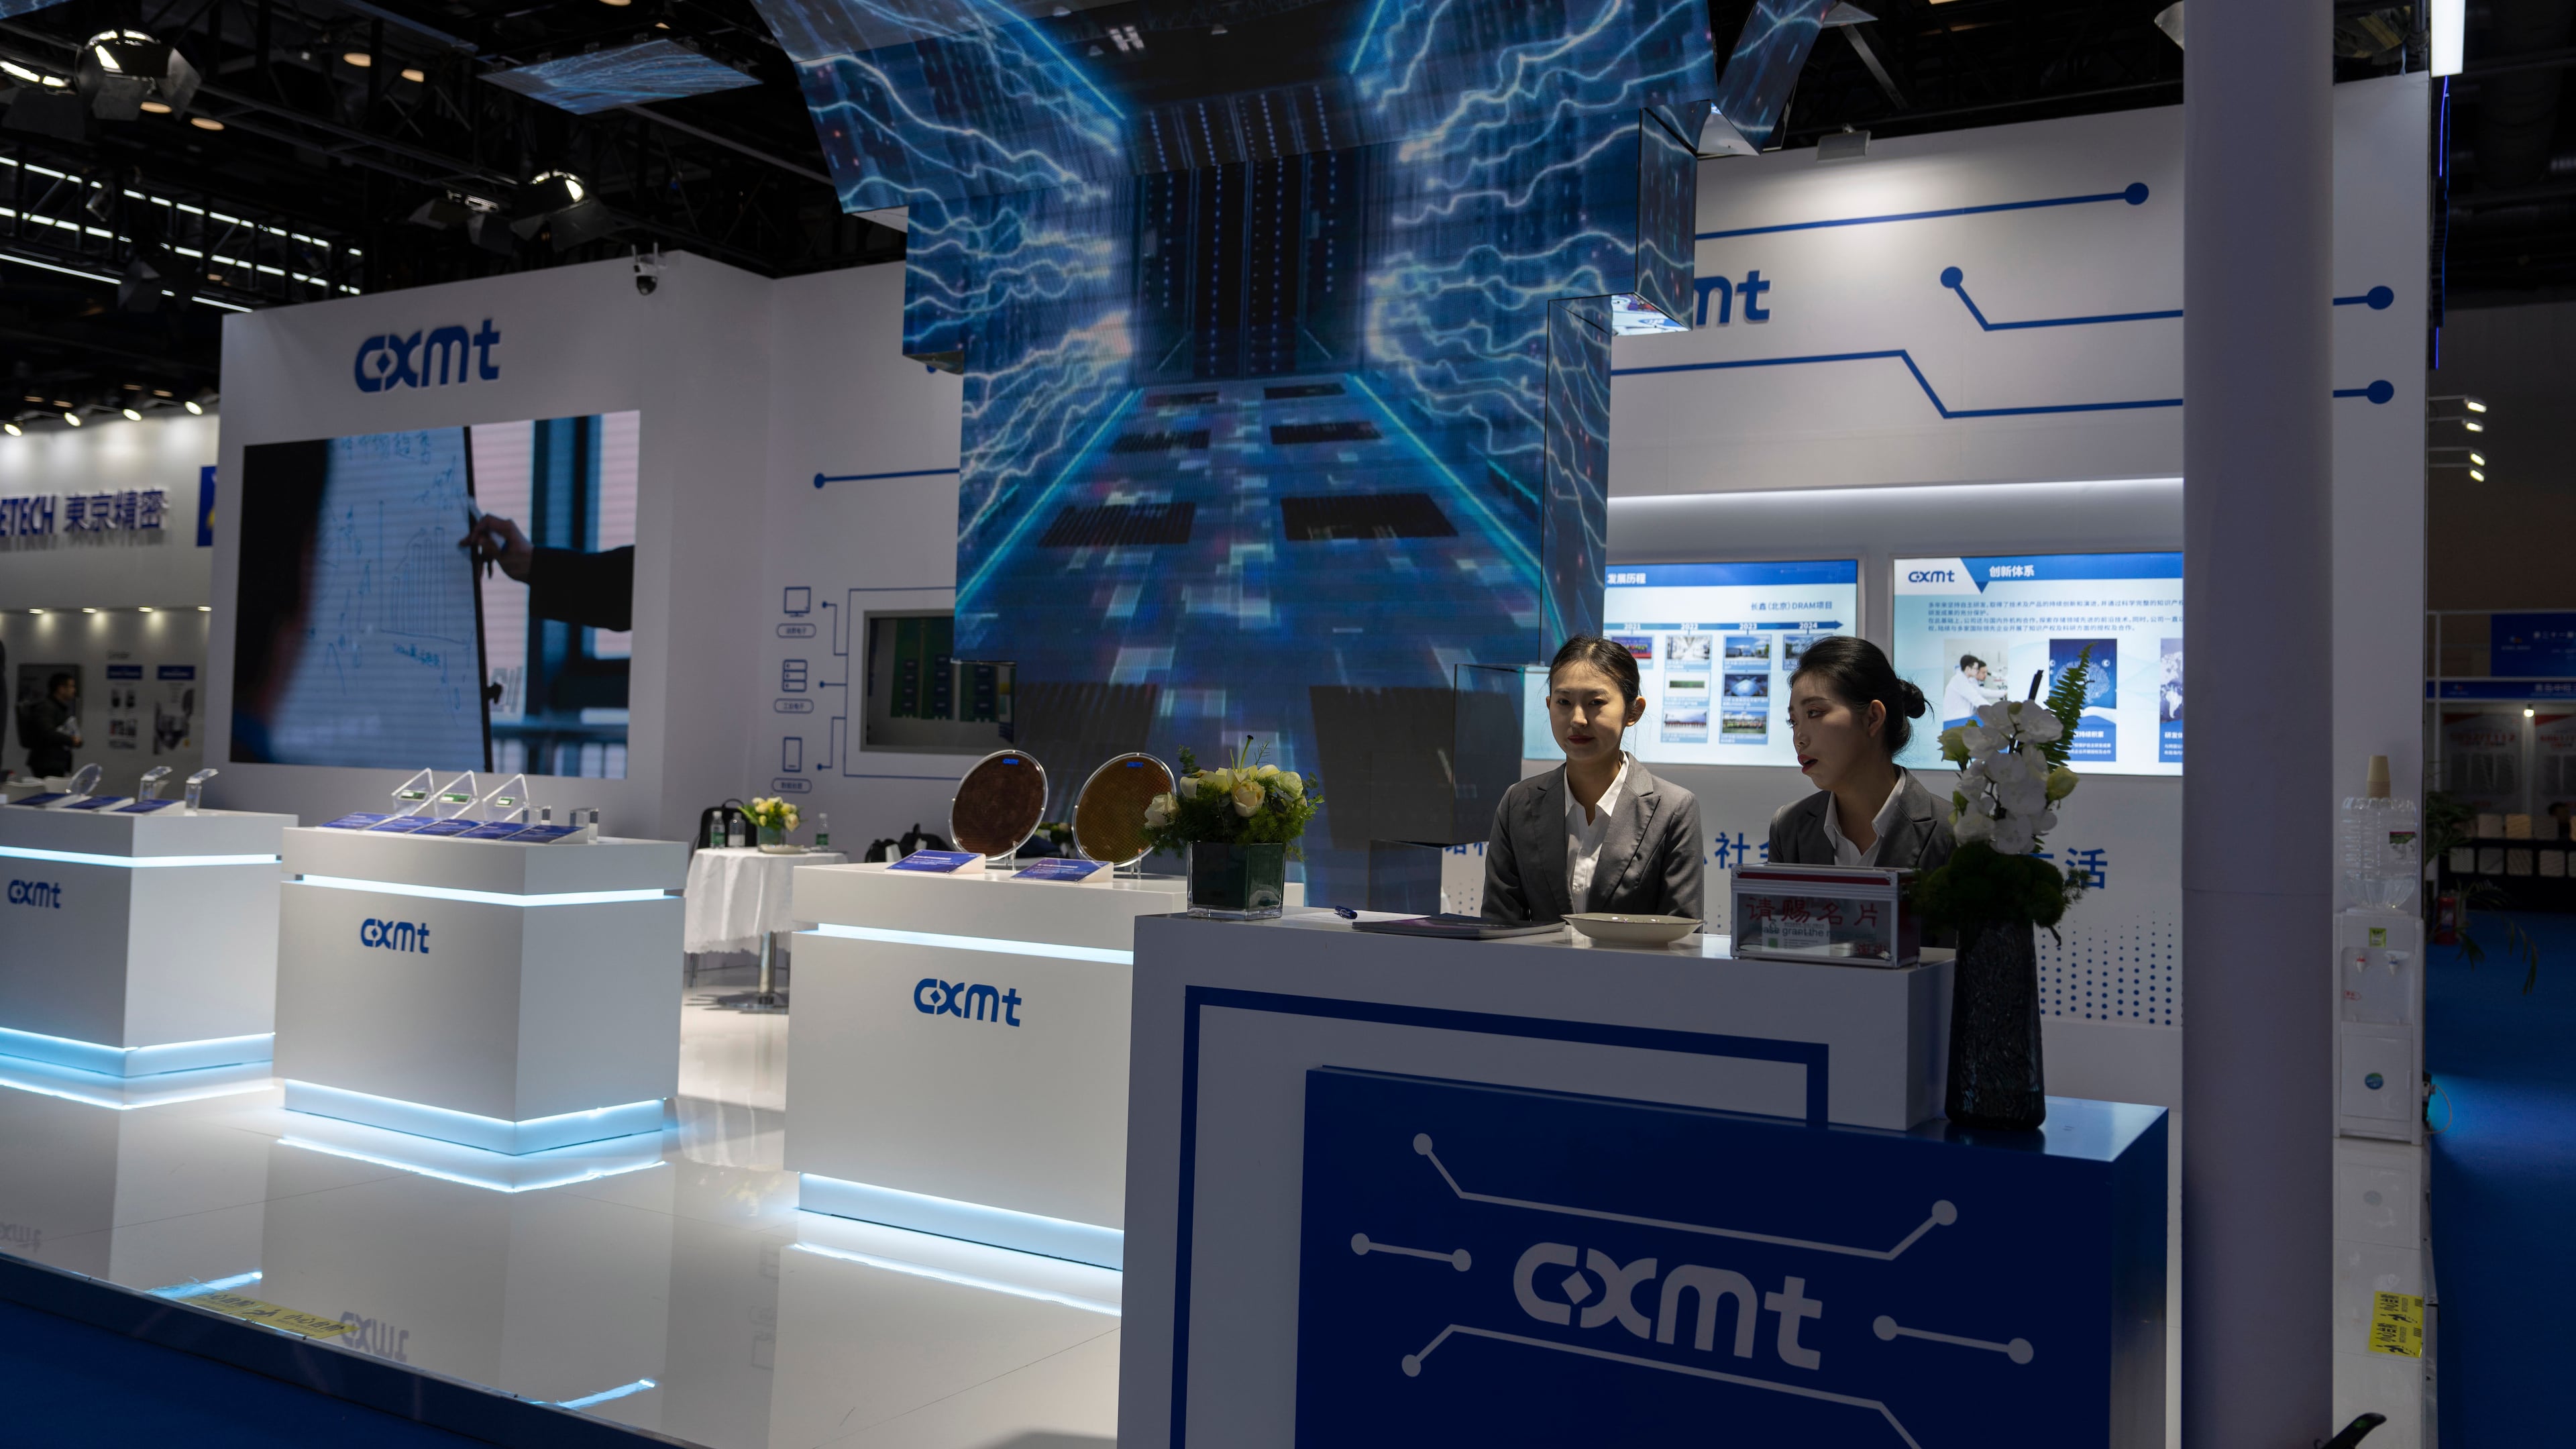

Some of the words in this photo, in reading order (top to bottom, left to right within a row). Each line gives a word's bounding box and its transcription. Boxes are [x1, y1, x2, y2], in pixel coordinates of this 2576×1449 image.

[1694, 270, 1770, 327] mt
[64, 488, 165, 532] 東京精密
[1607, 572, 1647, 585] 发展历程
[1909, 570, 1955, 584] cxmt
[1989, 565, 2035, 578] 创新体系
[1746, 896, 1879, 928] 请赐名片
[914, 978, 1022, 1027] cxmt
[1513, 1242, 1823, 1371] cxmt
